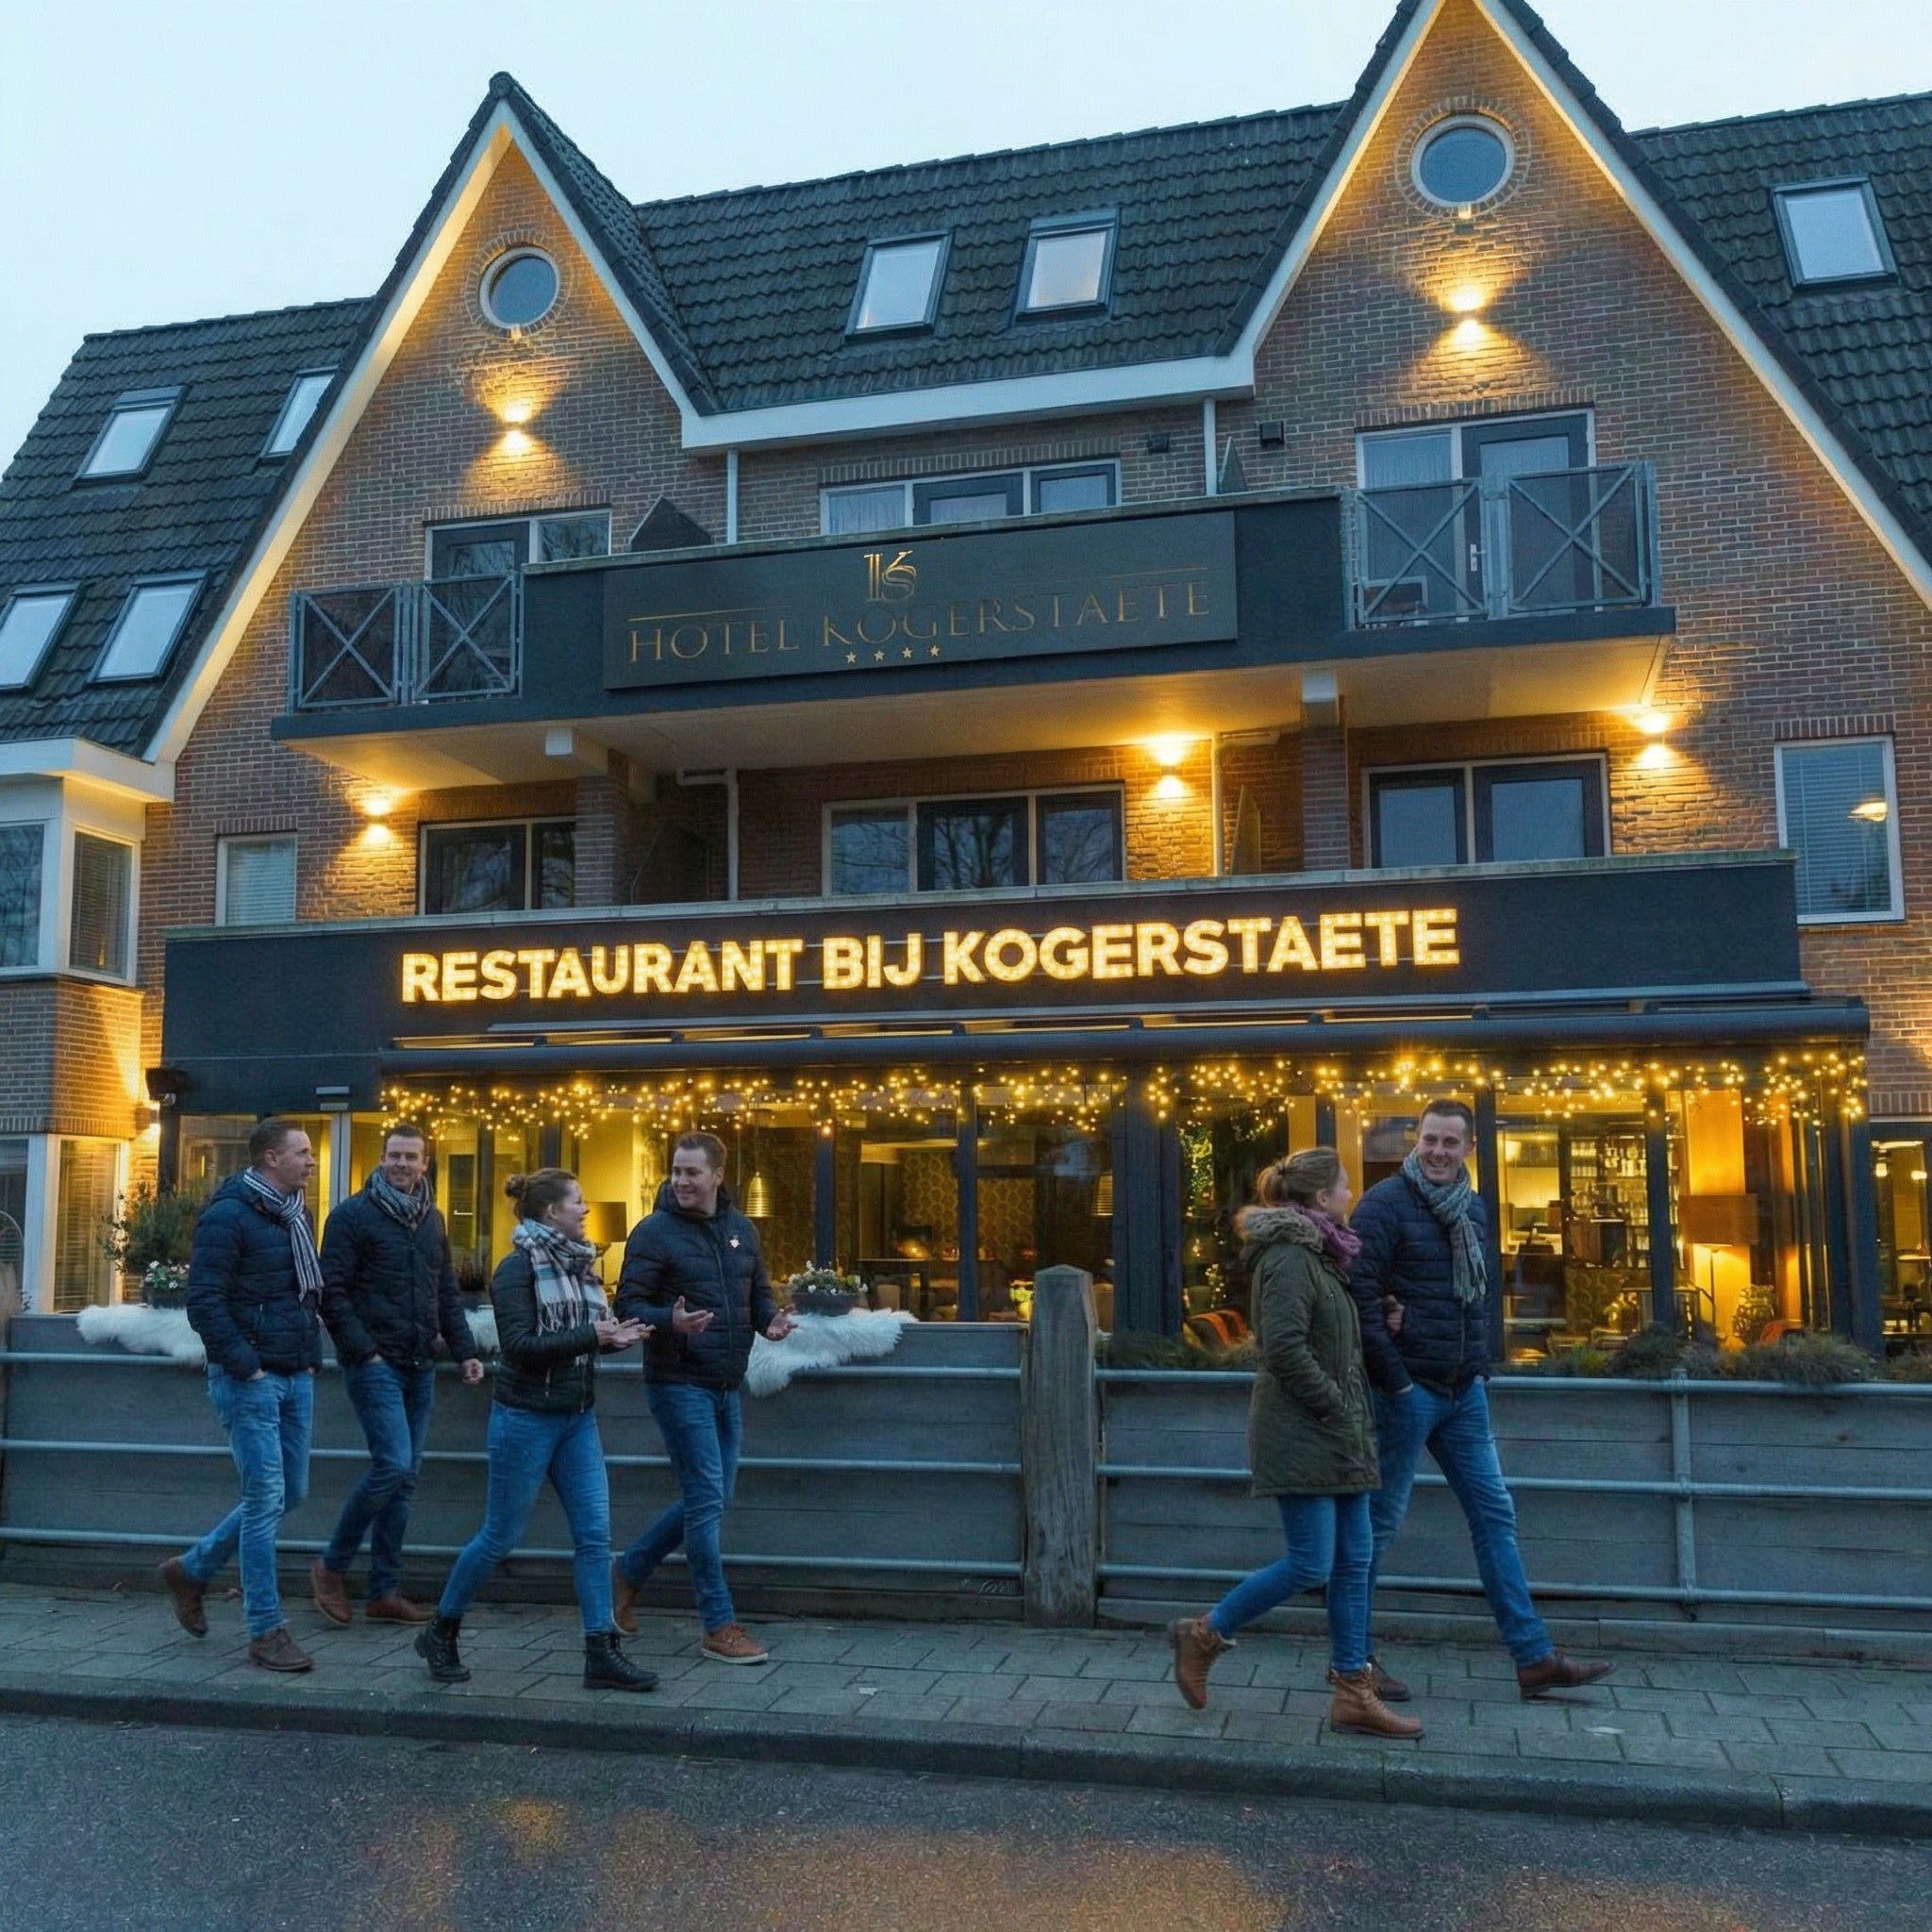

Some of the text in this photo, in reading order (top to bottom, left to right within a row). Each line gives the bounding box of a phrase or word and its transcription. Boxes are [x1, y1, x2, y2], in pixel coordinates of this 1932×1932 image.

[628, 581, 1211, 662] HOTEL KOGERSTAETE
[401, 908, 1460, 1004] RESTAURANT BIJ KOGERSTAETE
